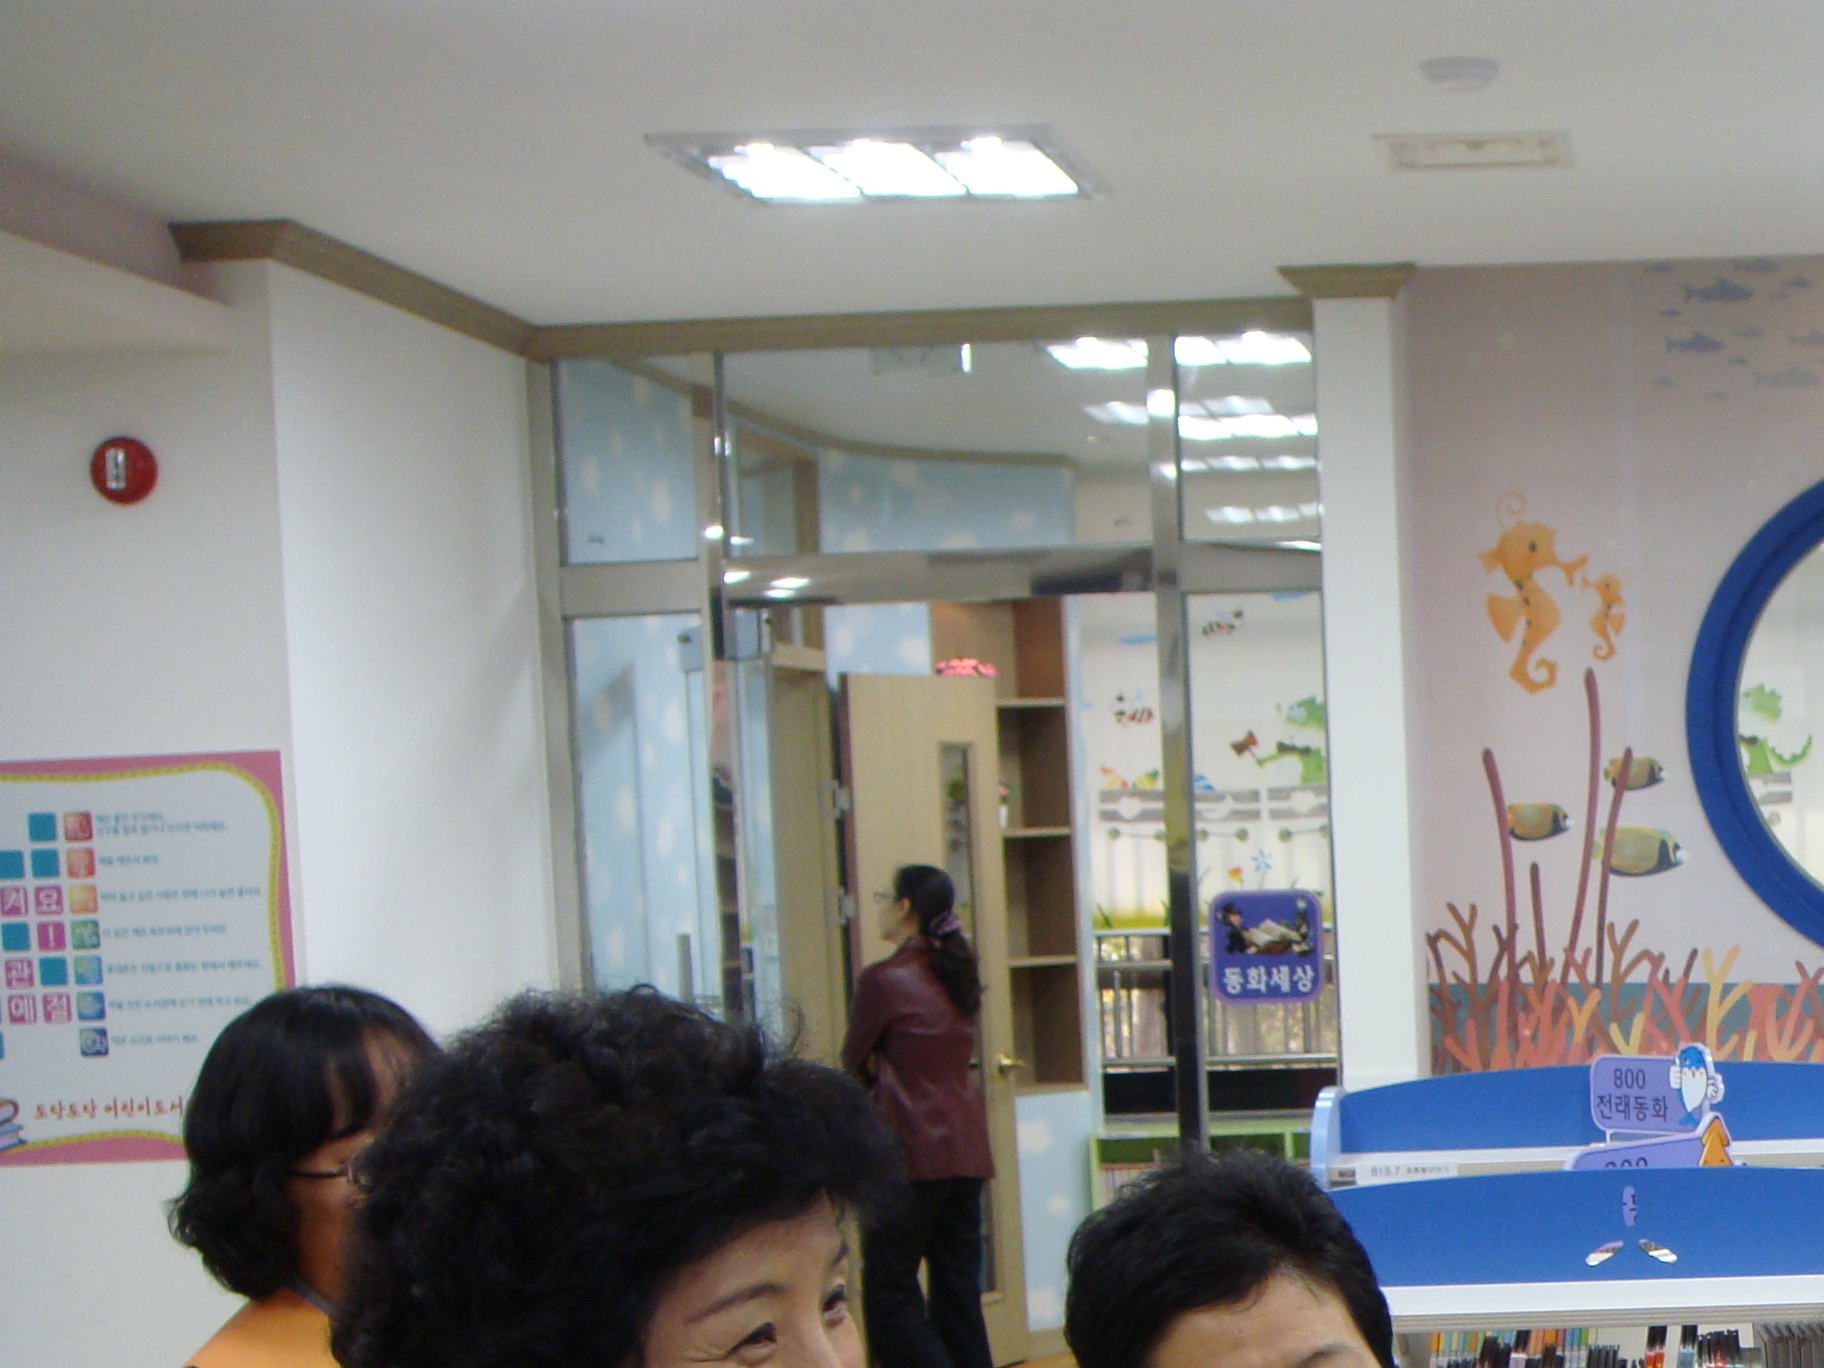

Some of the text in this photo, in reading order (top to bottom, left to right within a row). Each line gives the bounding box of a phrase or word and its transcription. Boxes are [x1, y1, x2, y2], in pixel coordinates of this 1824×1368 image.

[1223, 964, 1316, 995] 동화세상
[1613, 1068, 1646, 1090] 800
[1596, 1093, 1668, 1122] 전래동화
